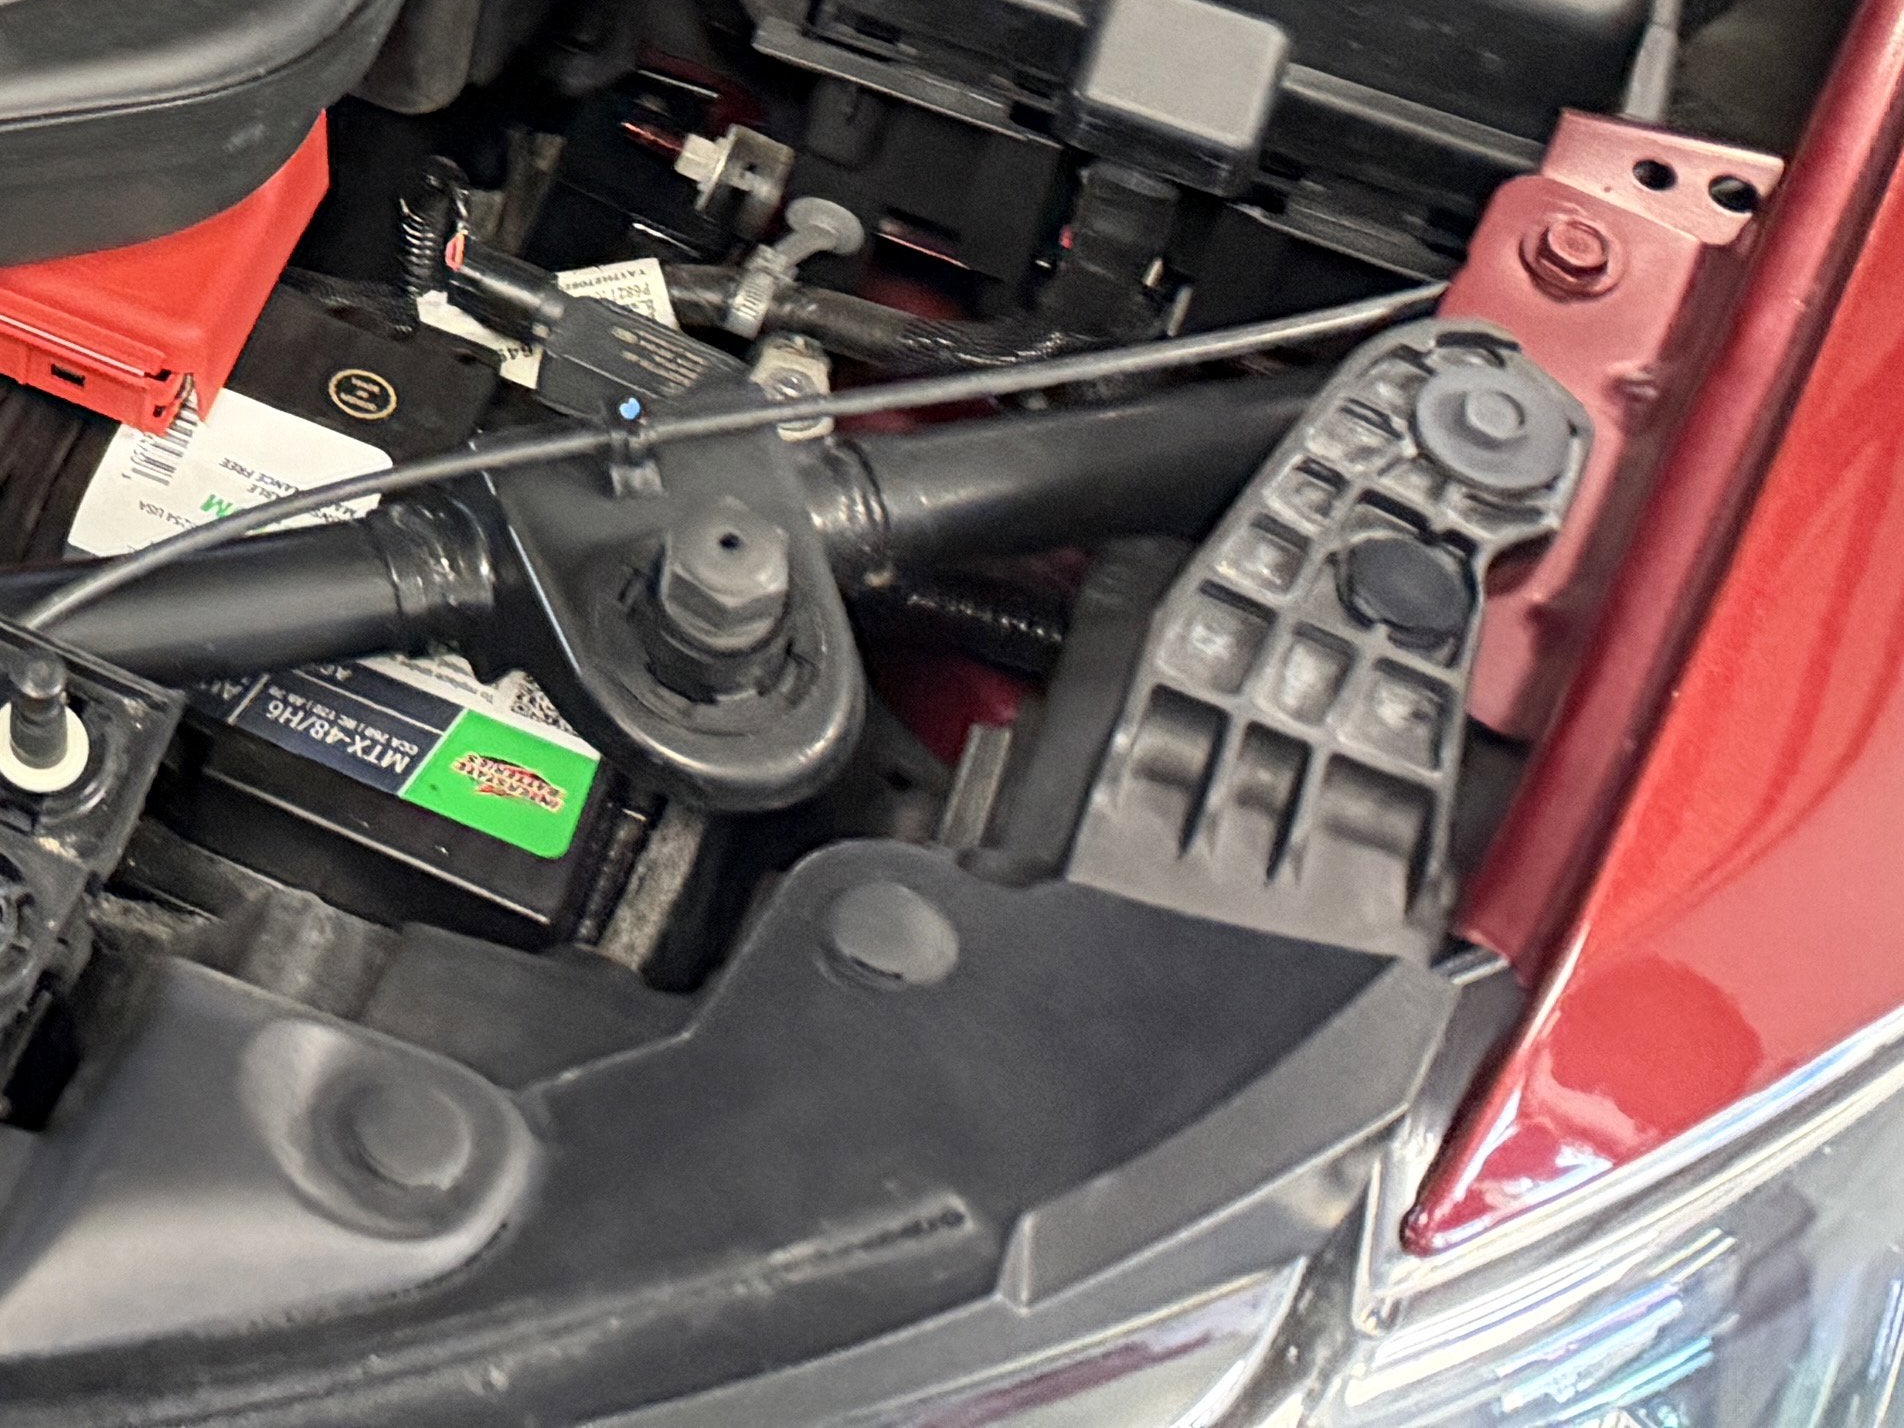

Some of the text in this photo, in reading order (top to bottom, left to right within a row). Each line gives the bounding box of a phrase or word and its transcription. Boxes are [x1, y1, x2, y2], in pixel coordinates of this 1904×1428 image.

[218, 455, 255, 478] FREE
[137, 499, 164, 518] USA
[263, 698, 411, 775] MTX-48/H6
